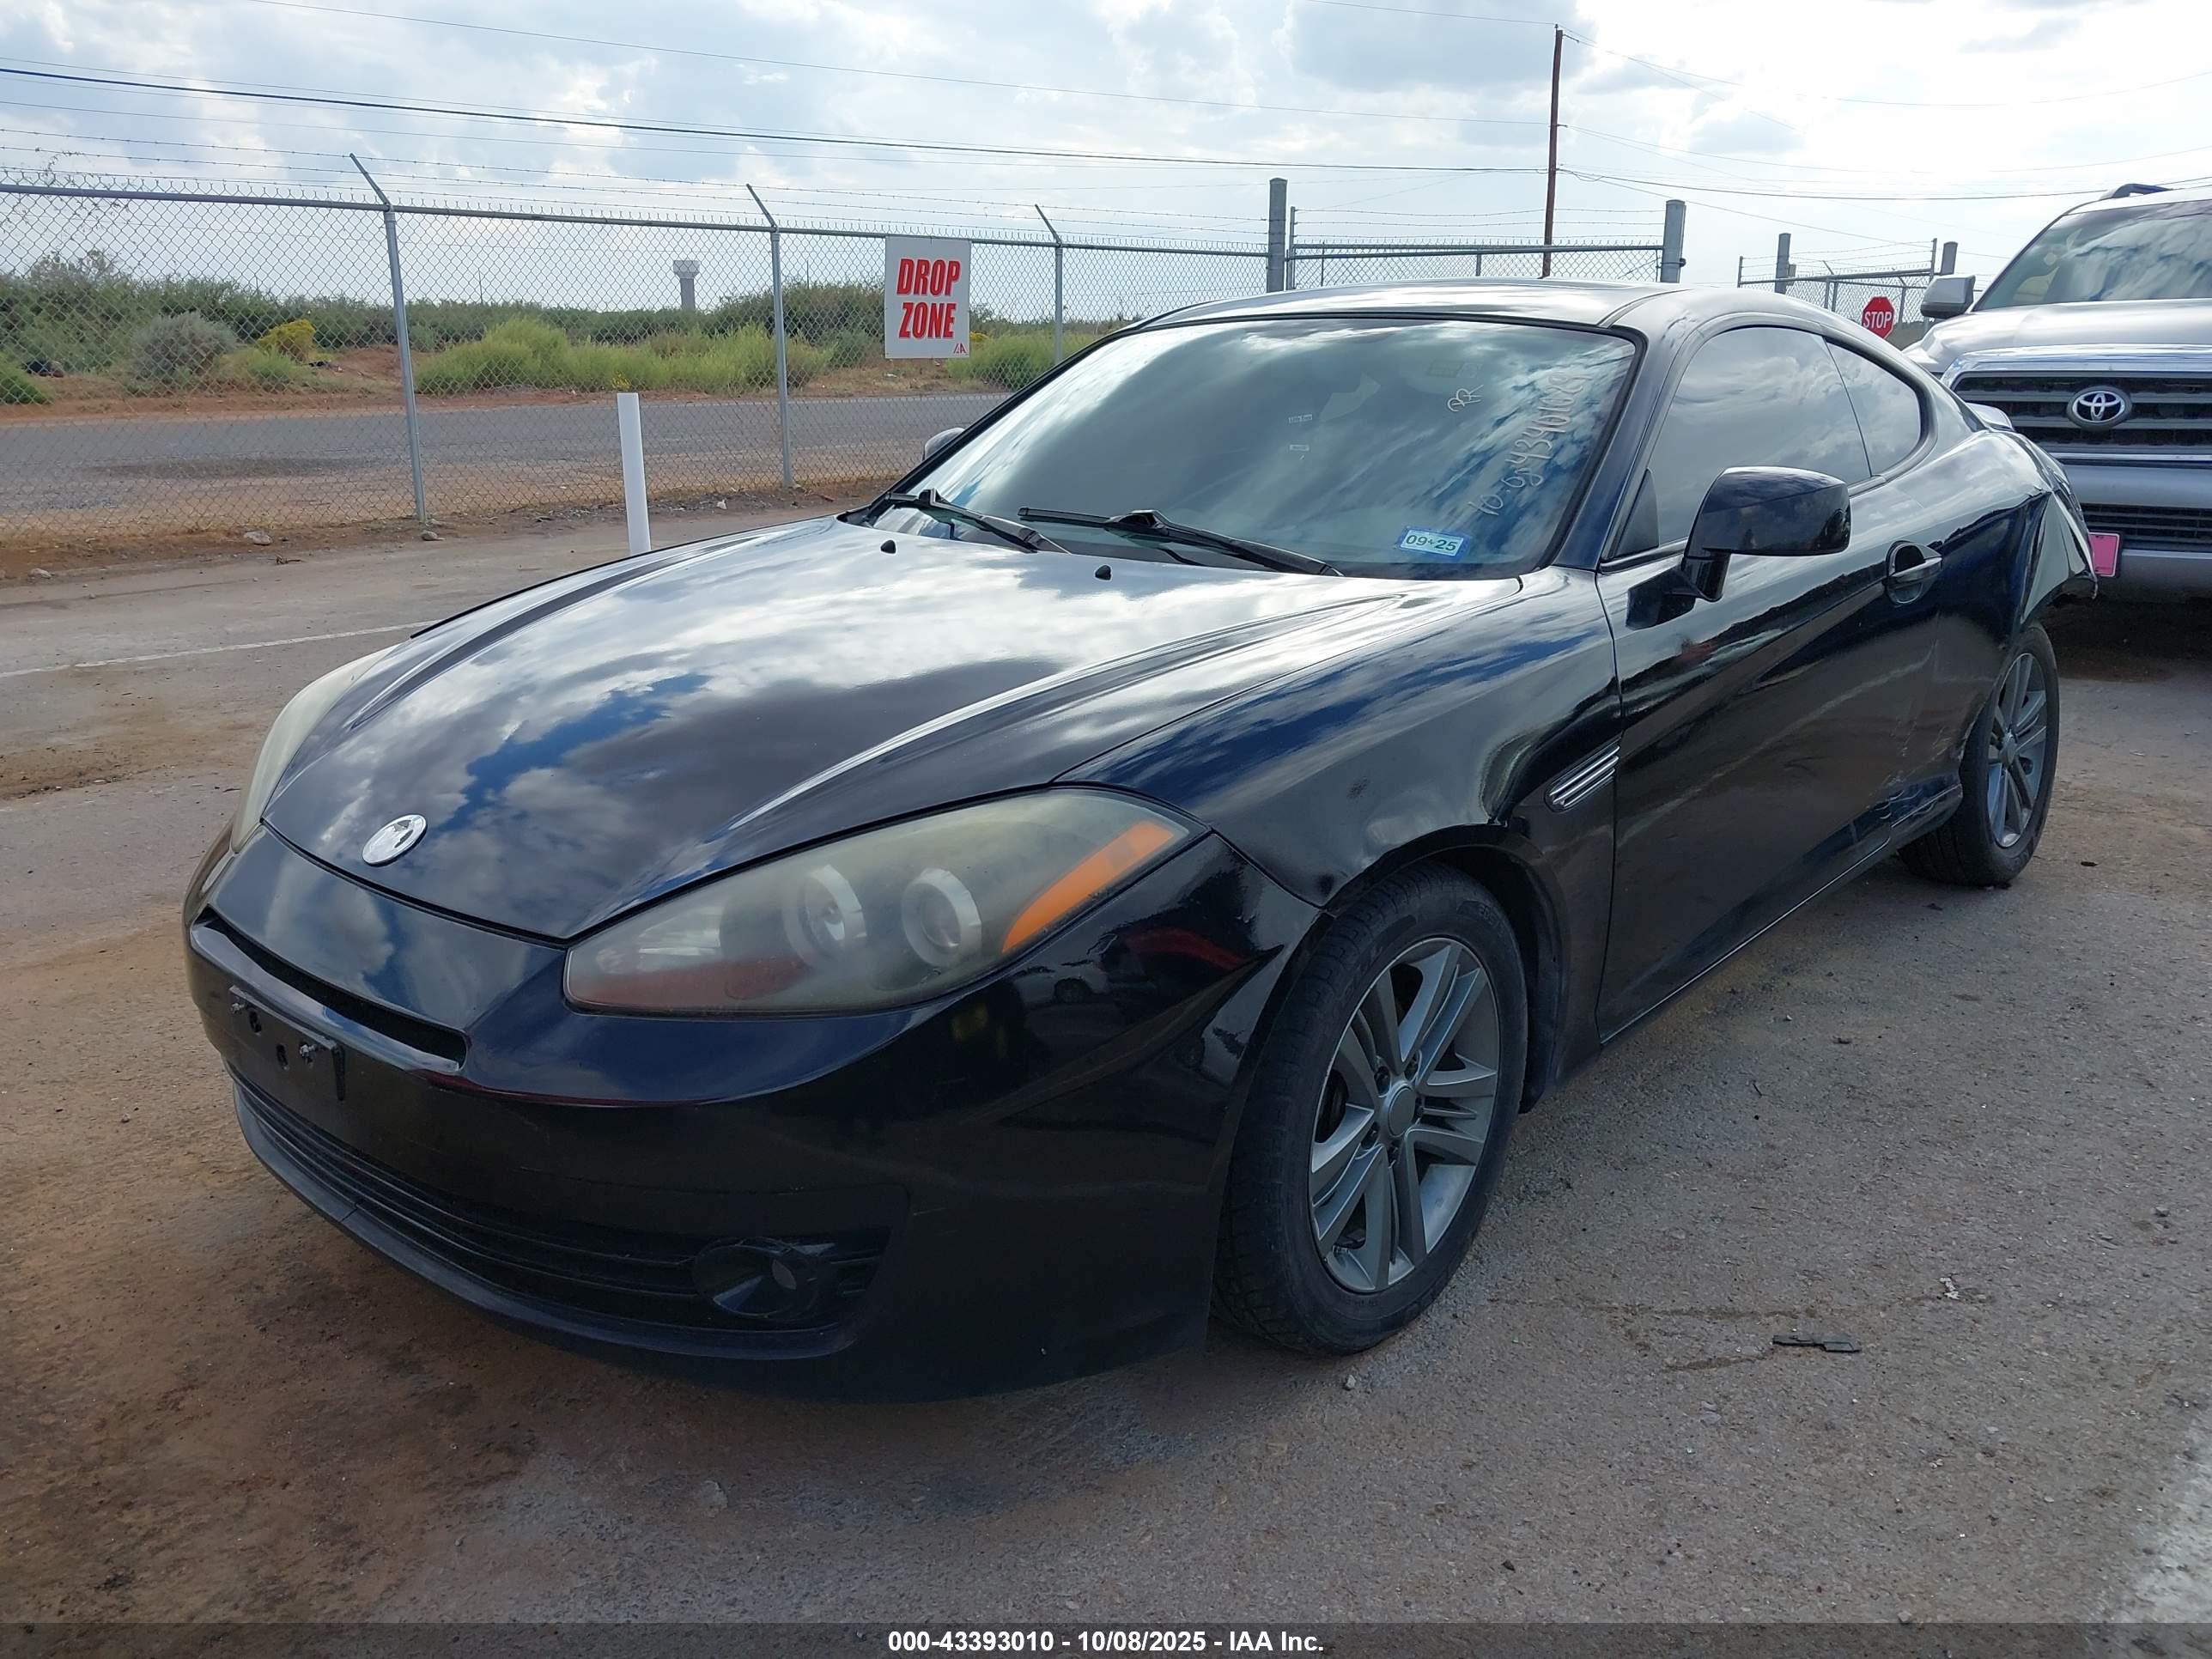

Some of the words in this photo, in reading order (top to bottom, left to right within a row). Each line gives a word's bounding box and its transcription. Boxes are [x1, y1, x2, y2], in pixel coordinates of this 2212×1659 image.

[896, 258, 960, 295] DROP
[899, 302, 956, 338] ZONE
[1863, 311, 1892, 328] STOP
